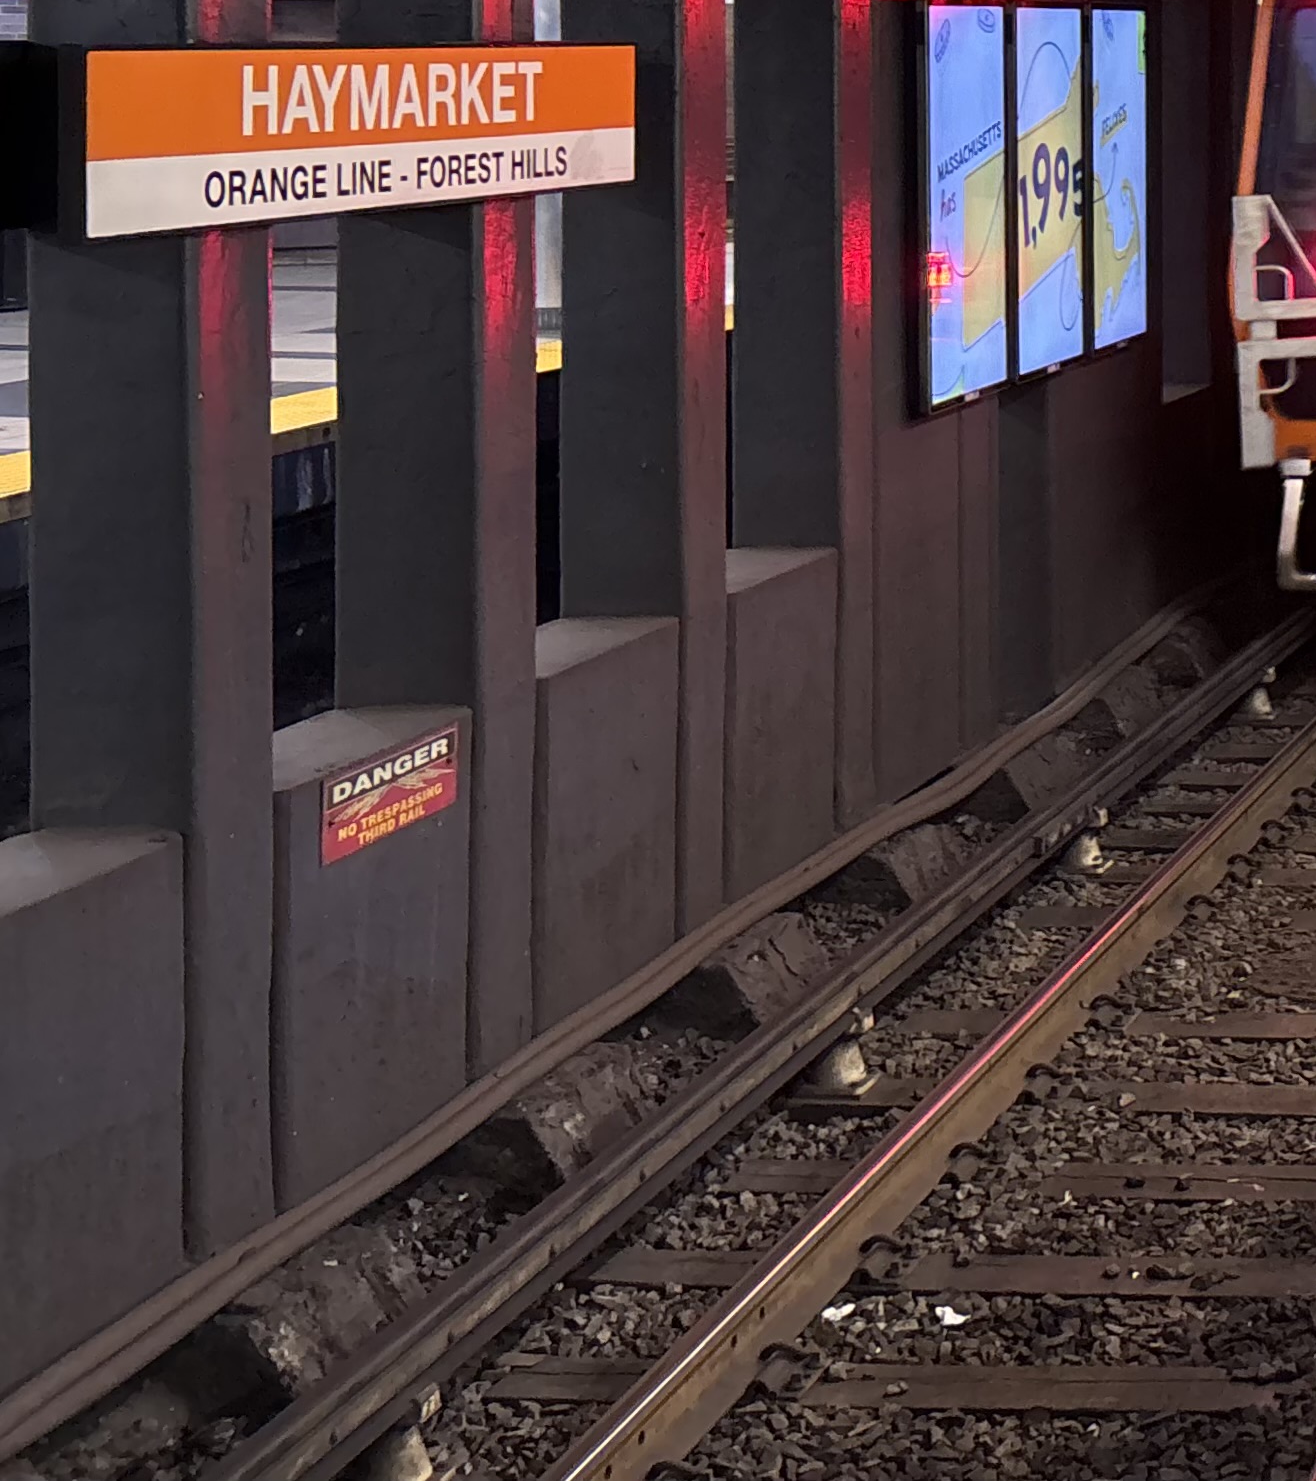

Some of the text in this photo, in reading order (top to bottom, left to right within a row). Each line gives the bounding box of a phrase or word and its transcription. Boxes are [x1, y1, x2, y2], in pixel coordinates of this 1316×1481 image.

[242, 60, 543, 136] HAYMARKET
[205, 163, 328, 208] ORANGE
[337, 160, 392, 197] LINE
[416, 151, 504, 190] FOREST
[511, 146, 567, 180] HILLS
[936, 120, 1002, 183] MASSACHUSETTS
[332, 737, 449, 804] DANGER
[337, 783, 443, 842] NO TRESPASSING
[358, 805, 426, 846] THIRD RAIL
